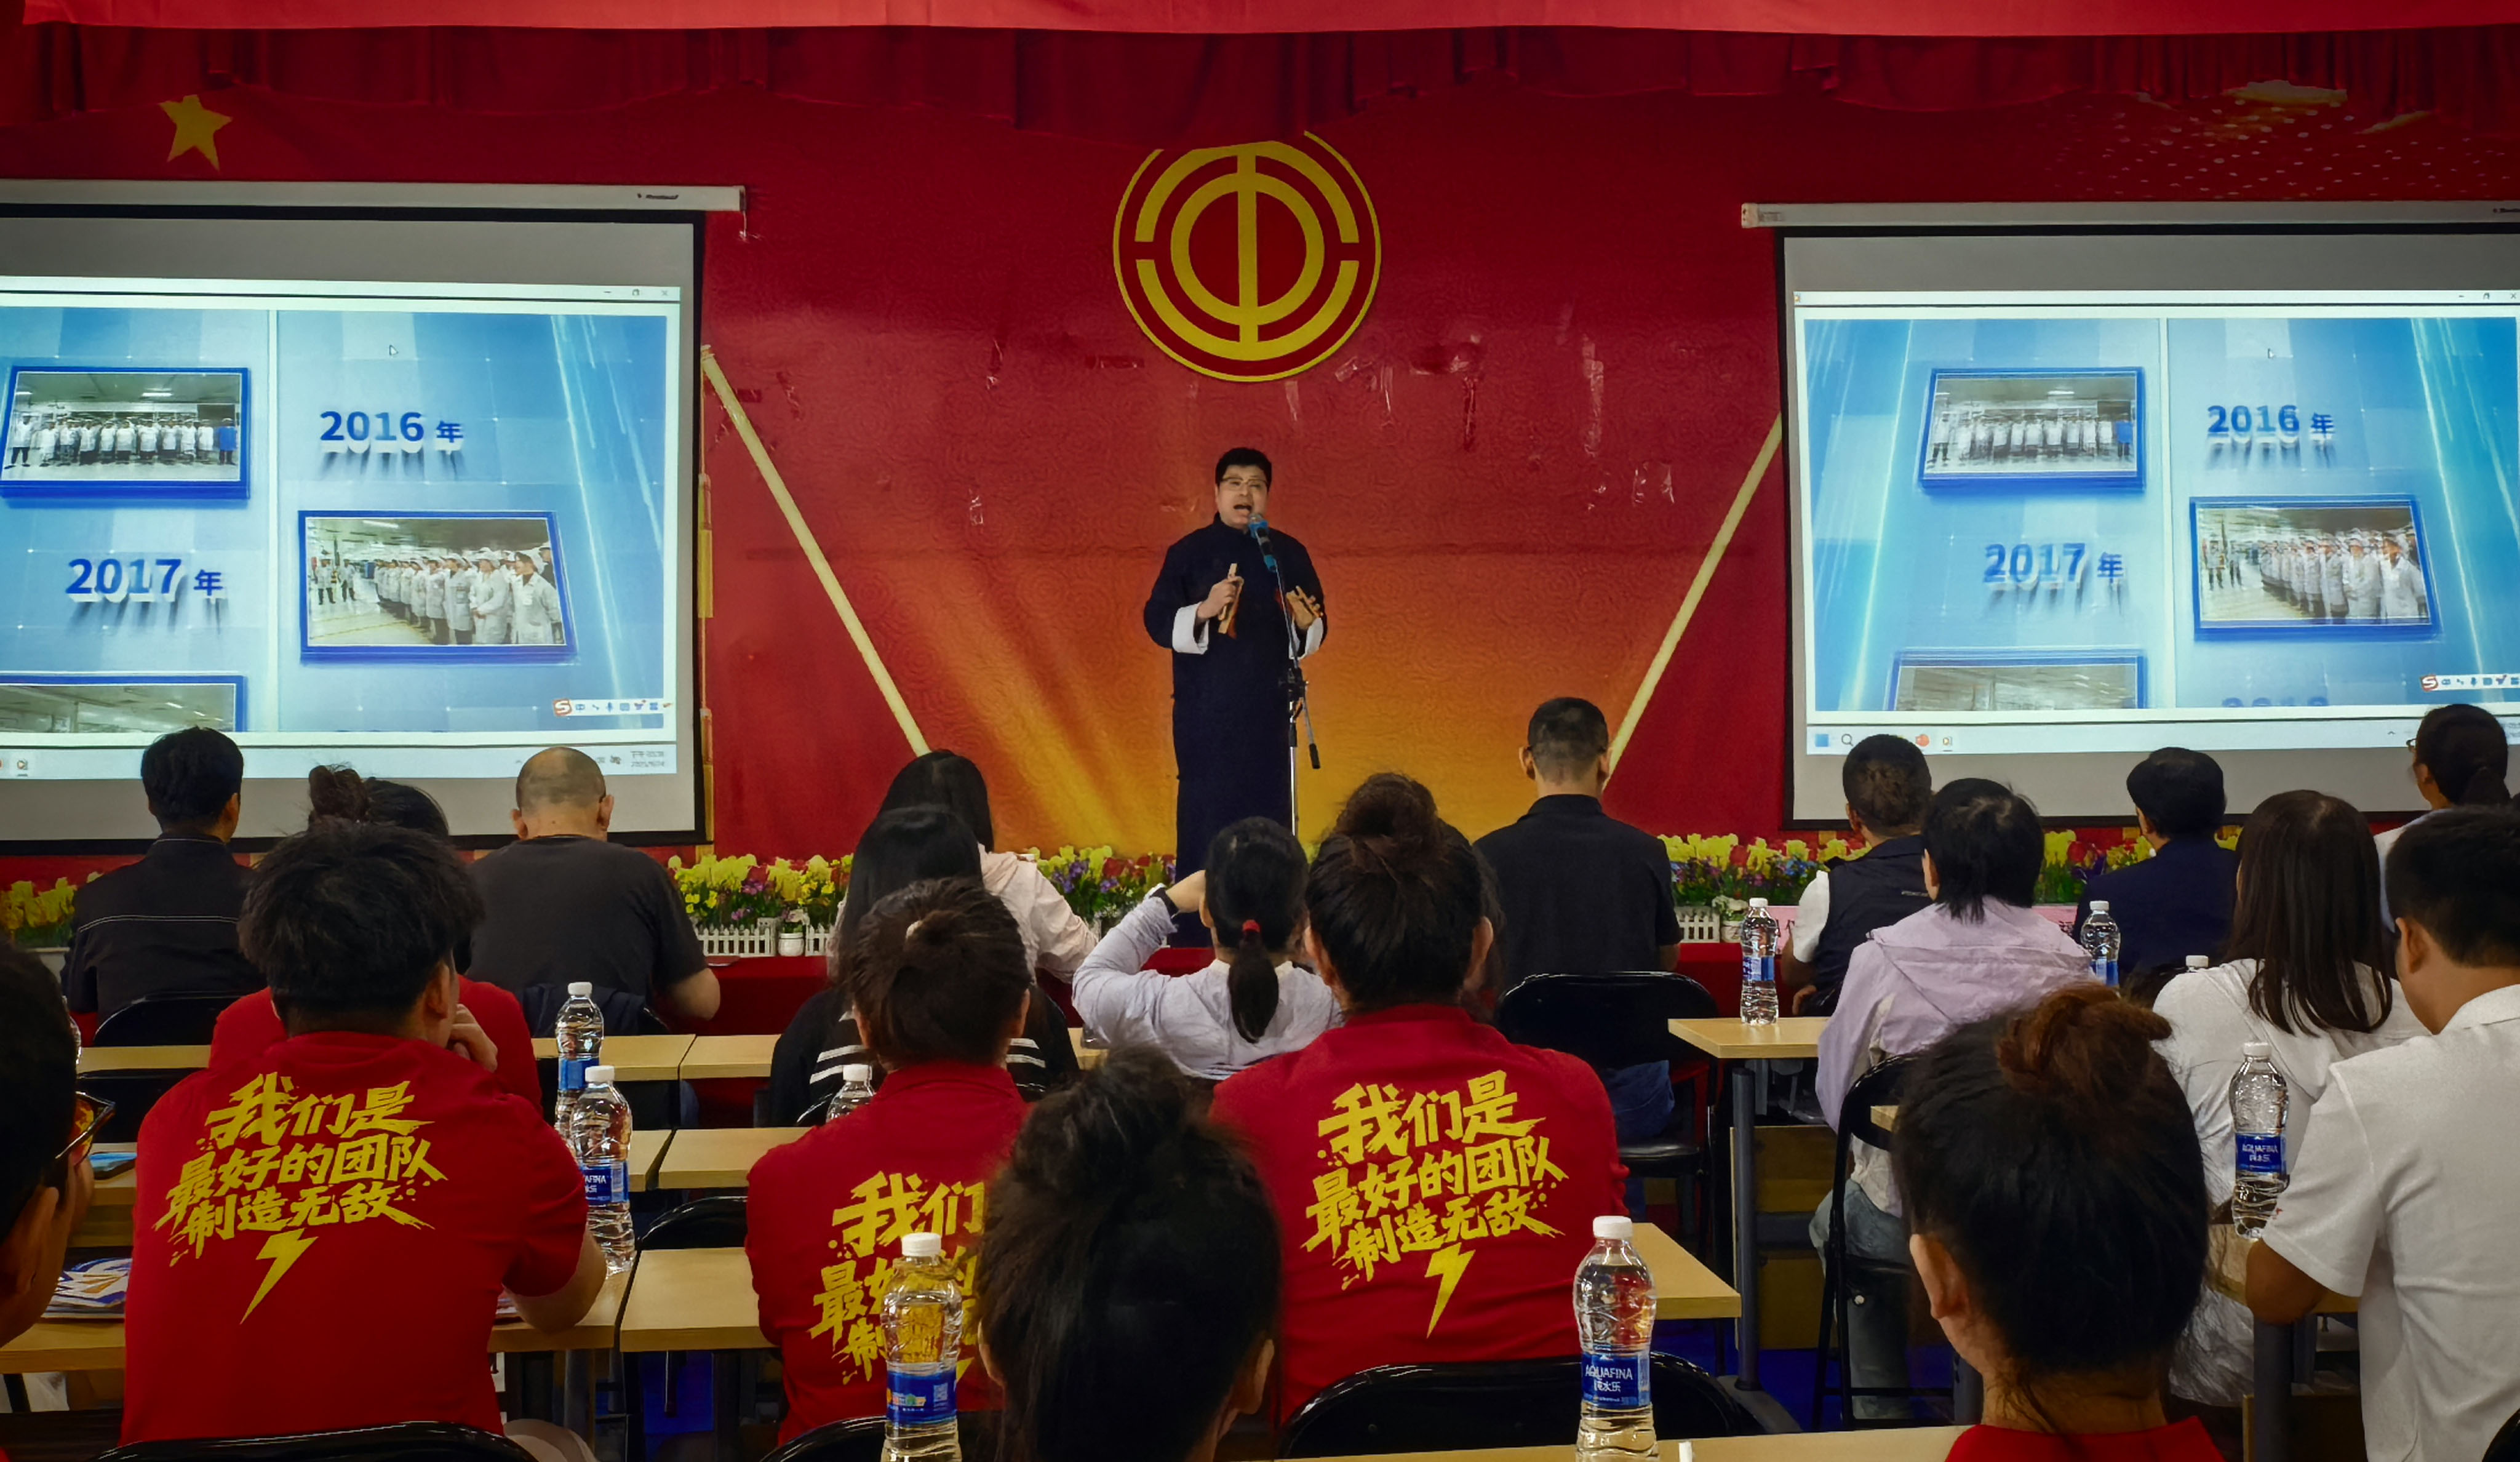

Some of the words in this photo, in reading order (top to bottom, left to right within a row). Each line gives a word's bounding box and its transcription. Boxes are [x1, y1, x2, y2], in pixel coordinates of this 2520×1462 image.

[320, 411, 425, 441] 2016
[436, 420, 464, 443] 年
[2207, 405, 2300, 434] 2016
[2310, 412, 2335, 435] 年
[65, 559, 182, 594] 2017
[193, 569, 223, 596] 年
[1983, 543, 2086, 583] 2017
[2097, 551, 2123, 583] 年
[205, 1071, 435, 1146] 我们是
[1318, 1069, 1546, 1165] 我们是
[153, 1133, 449, 1231] 最好的团队
[1300, 1136, 1569, 1258] 最好的团队
[172, 1182, 436, 1260] 制造无敌
[1338, 1188, 1566, 1281] 制造无敌
[1584, 1364, 1633, 1380] AQUAFINA
